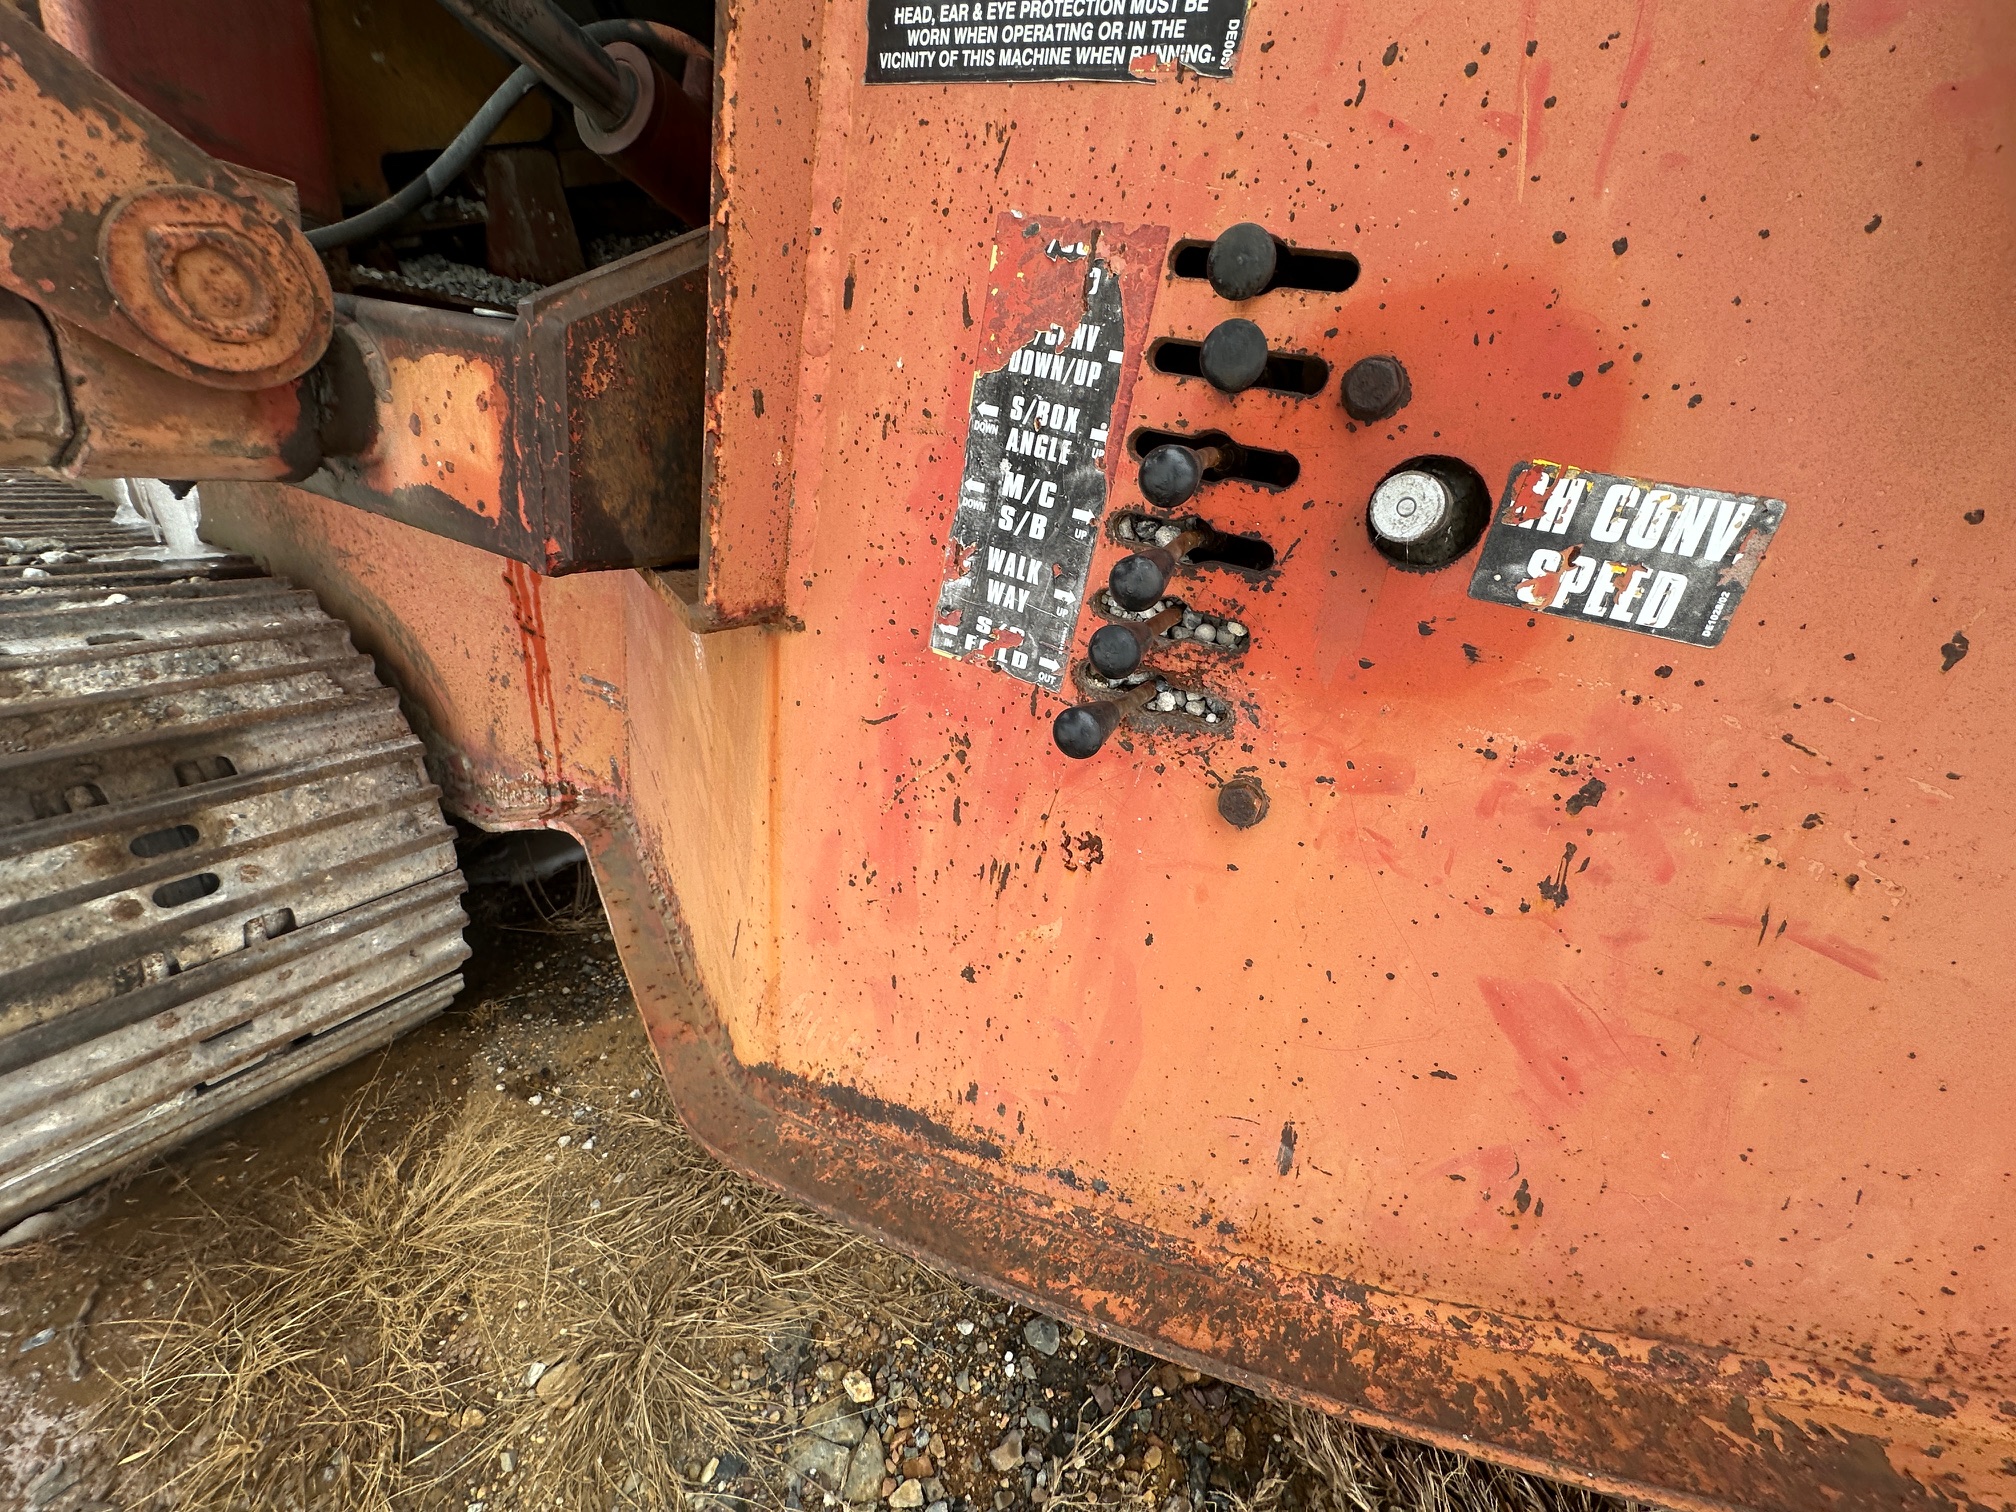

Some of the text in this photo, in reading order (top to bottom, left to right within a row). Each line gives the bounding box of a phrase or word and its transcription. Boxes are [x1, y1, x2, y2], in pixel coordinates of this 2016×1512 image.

[894, 0, 1210, 26] HEAD, EAR & EYE PROTECTION MUST BE
[907, 18, 1187, 46] WORN WHEN OPERATING OR IN THE
[879, 51, 936, 69] VICINITY
[938, 50, 959, 68] OF
[961, 48, 996, 67] THIS
[998, 47, 1072, 67] MACHINE
[1076, 46, 1125, 65] WHEN
[1007, 348, 1103, 388] DOWN/UP
[973, 420, 999, 436] DOWN
[1009, 395, 1081, 434] S/BOX
[1005, 427, 1073, 466] ANGLE
[1091, 447, 1106, 459] UP
[1001, 470, 1058, 509] M/C
[961, 497, 987, 512] DOWN
[998, 504, 1048, 541] S/B
[1074, 528, 1088, 540] UP
[986, 545, 1043, 586] WALK
[986, 578, 1031, 613] WAY
[1516, 548, 1689, 629] SPEED
[1056, 606, 1069, 618] UP
[1038, 671, 1057, 685] OUT
